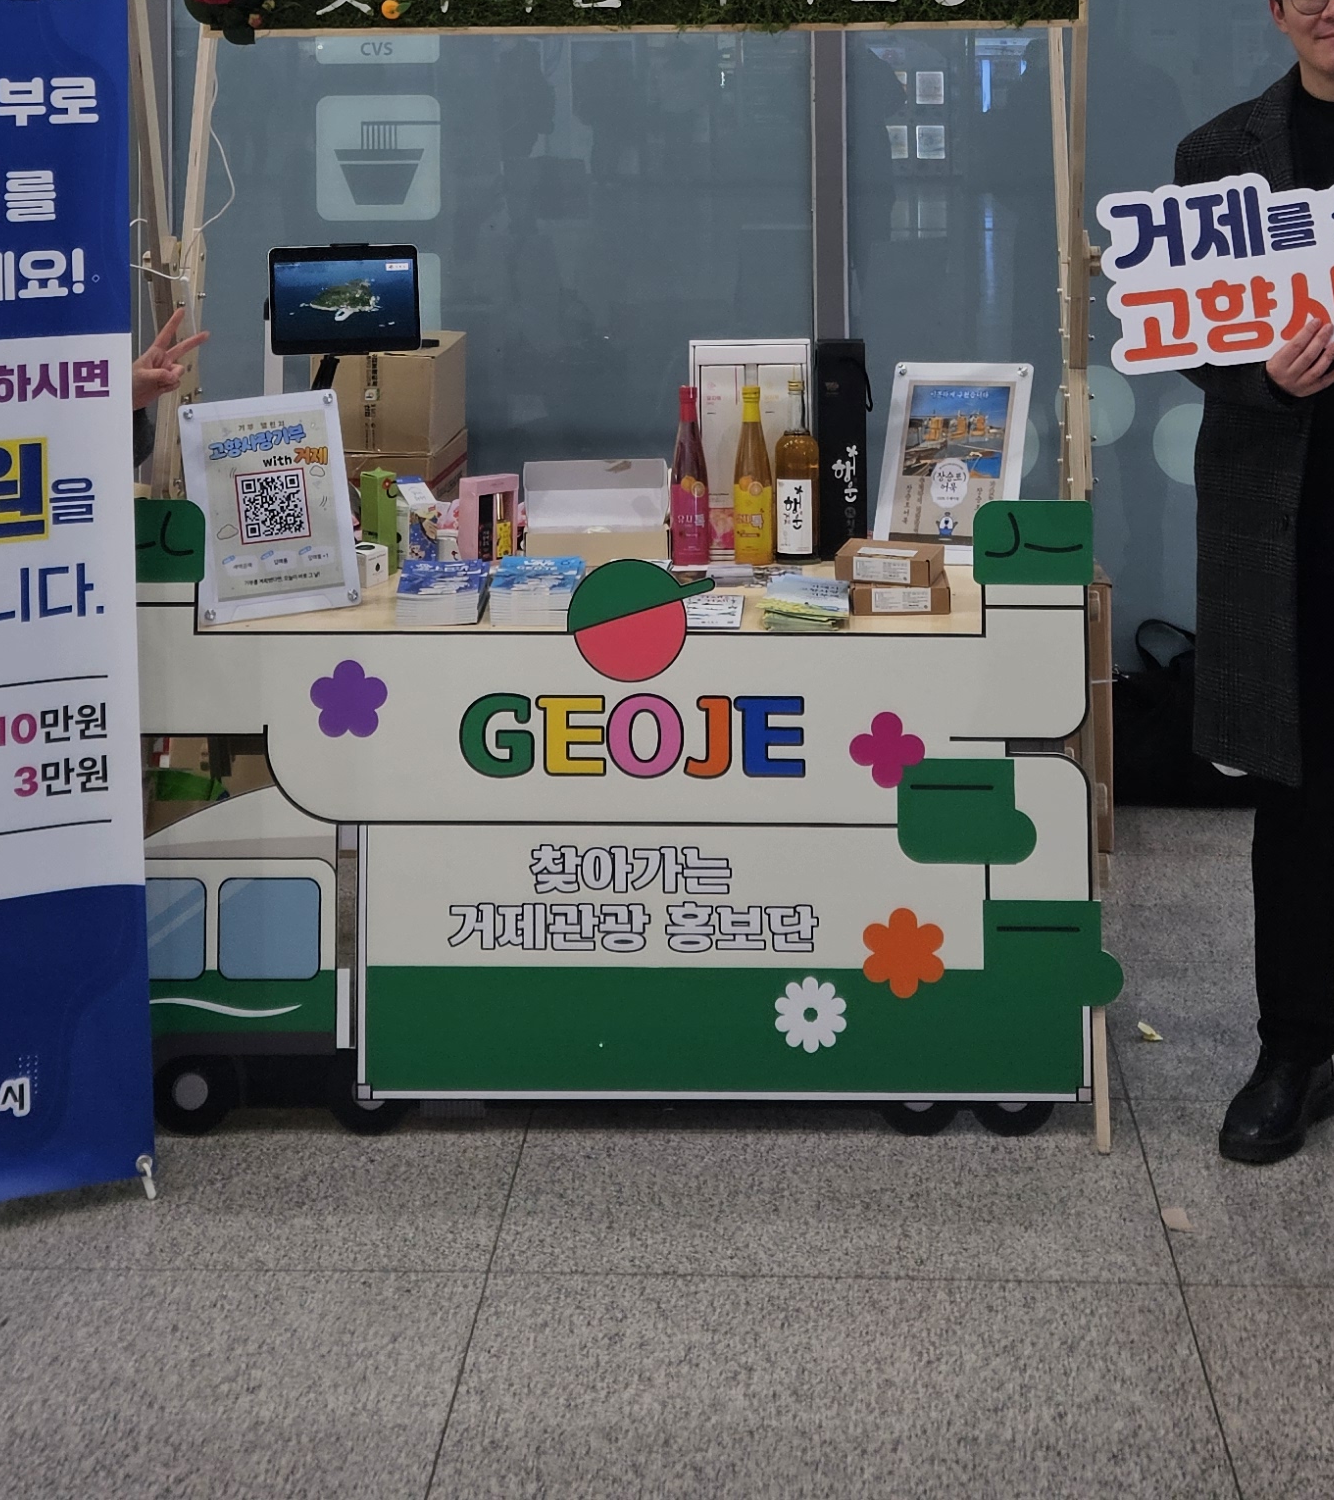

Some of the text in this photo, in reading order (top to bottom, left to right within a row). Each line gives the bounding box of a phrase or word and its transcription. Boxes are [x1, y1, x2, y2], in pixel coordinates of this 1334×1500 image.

[360, 42, 393, 56] CVS
[1110, 186, 1316, 270] 거제를
[208, 424, 306, 461] 고향사랑기부
[263, 446, 329, 468] with 거제
[459, 691, 807, 779] GEOJE
[14, 755, 110, 798] 3만원
[530, 843, 733, 895] 찾아가는
[448, 903, 819, 954] 거제관광 홍보단
